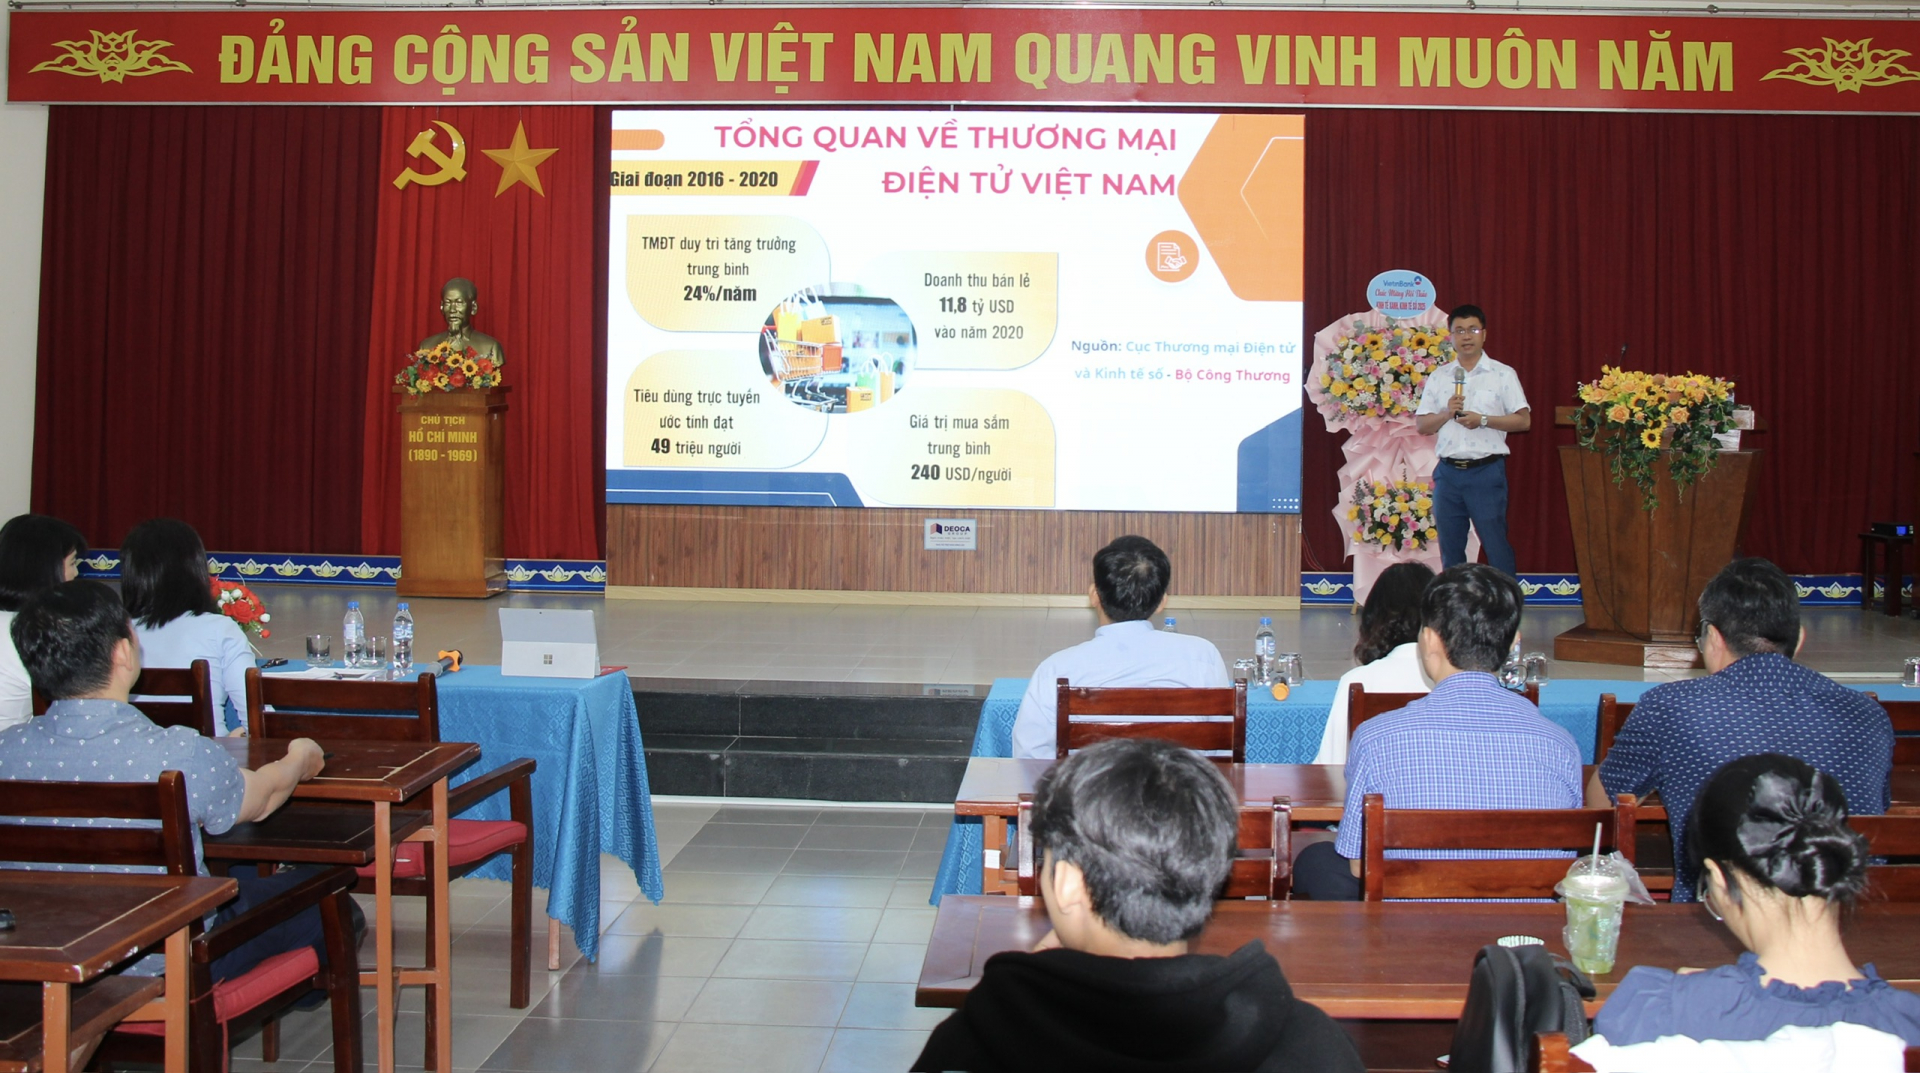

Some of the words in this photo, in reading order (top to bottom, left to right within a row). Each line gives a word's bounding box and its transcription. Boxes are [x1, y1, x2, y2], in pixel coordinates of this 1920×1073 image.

[218, 18, 373, 85] ĐẢNG
[393, 24, 549, 95] CỘNG
[570, 16, 689, 84] SẢN
[710, 22, 834, 94] VIỆT
[854, 33, 992, 83] NAM
[1015, 32, 1215, 90] QUANG
[1236, 34, 1376, 87] VINH
[1399, 27, 1577, 90] MUÔN
[1599, 30, 1733, 91] NĂM
[714, 117, 803, 149] TỔNG
[813, 125, 906, 153] QUAN
[917, 118, 958, 149] VỀ
[967, 123, 1106, 150] THƯƠNG
[1118, 128, 1176, 156] MẠI
[609, 171, 639, 187] Giai
[644, 171, 683, 190] đoạn
[687, 171, 724, 187] 2016
[739, 171, 778, 187] 2020
[882, 165, 959, 200] ĐIỆN
[970, 163, 1013, 194] TỬ
[1021, 167, 1092, 201] VIỆT
[1103, 173, 1175, 196] NAM
[642, 236, 675, 250] TMĐT
[680, 237, 701, 253] duy
[706, 237, 719, 250] trì
[724, 237, 752, 253] tăng
[756, 235, 796, 254] trưởng
[687, 262, 720, 279] trung
[724, 262, 749, 276] bình
[924, 272, 962, 287] Doanh
[967, 273, 987, 287] thu
[992, 273, 1014, 288] bán
[1019, 272, 1030, 288] lẻ
[683, 285, 757, 302] 24%/năm
[939, 296, 967, 314] 11,8
[972, 298, 984, 316] tỷ
[989, 299, 1014, 313] USD
[934, 325, 956, 339] vào
[961, 326, 987, 339] năm
[992, 325, 1024, 339] 2020
[1071, 339, 1122, 354] Nguồn:
[1126, 341, 1150, 355] Cục
[1155, 341, 1210, 356] Thương
[1214, 342, 1239, 356] mại
[1243, 342, 1275, 357] Điện
[1279, 341, 1297, 354] tử
[1074, 367, 1091, 379] và
[1095, 367, 1126, 379] Kinh
[1130, 366, 1145, 380] tế
[1148, 367, 1163, 380] số
[1175, 369, 1192, 383] Bộ
[1196, 369, 1231, 383] Công
[1236, 370, 1290, 384] Thương
[633, 389, 658, 403] Tiêu
[663, 389, 693, 407] dùng
[697, 390, 722, 406] trực
[727, 388, 760, 407] tuyến
[421, 414, 441, 425] CHỦ
[443, 416, 466, 427] TỊCH
[659, 415, 681, 429] ước
[686, 415, 708, 429] tính
[713, 415, 734, 432] đạt
[909, 414, 929, 428] Giá
[934, 415, 948, 431] trị
[953, 418, 978, 429] mua
[984, 414, 1010, 430] sắm
[426, 429, 445, 443] CHÍ
[447, 431, 478, 443] MINH
[408, 449, 438, 462] (1890
[447, 449, 478, 462] 1969)
[650, 438, 671, 454] 49
[675, 441, 703, 457] triệu
[708, 441, 741, 458] người
[927, 442, 960, 458] trung
[965, 441, 991, 455] bình
[911, 464, 940, 480] 240
[945, 467, 1012, 484] USD/người
